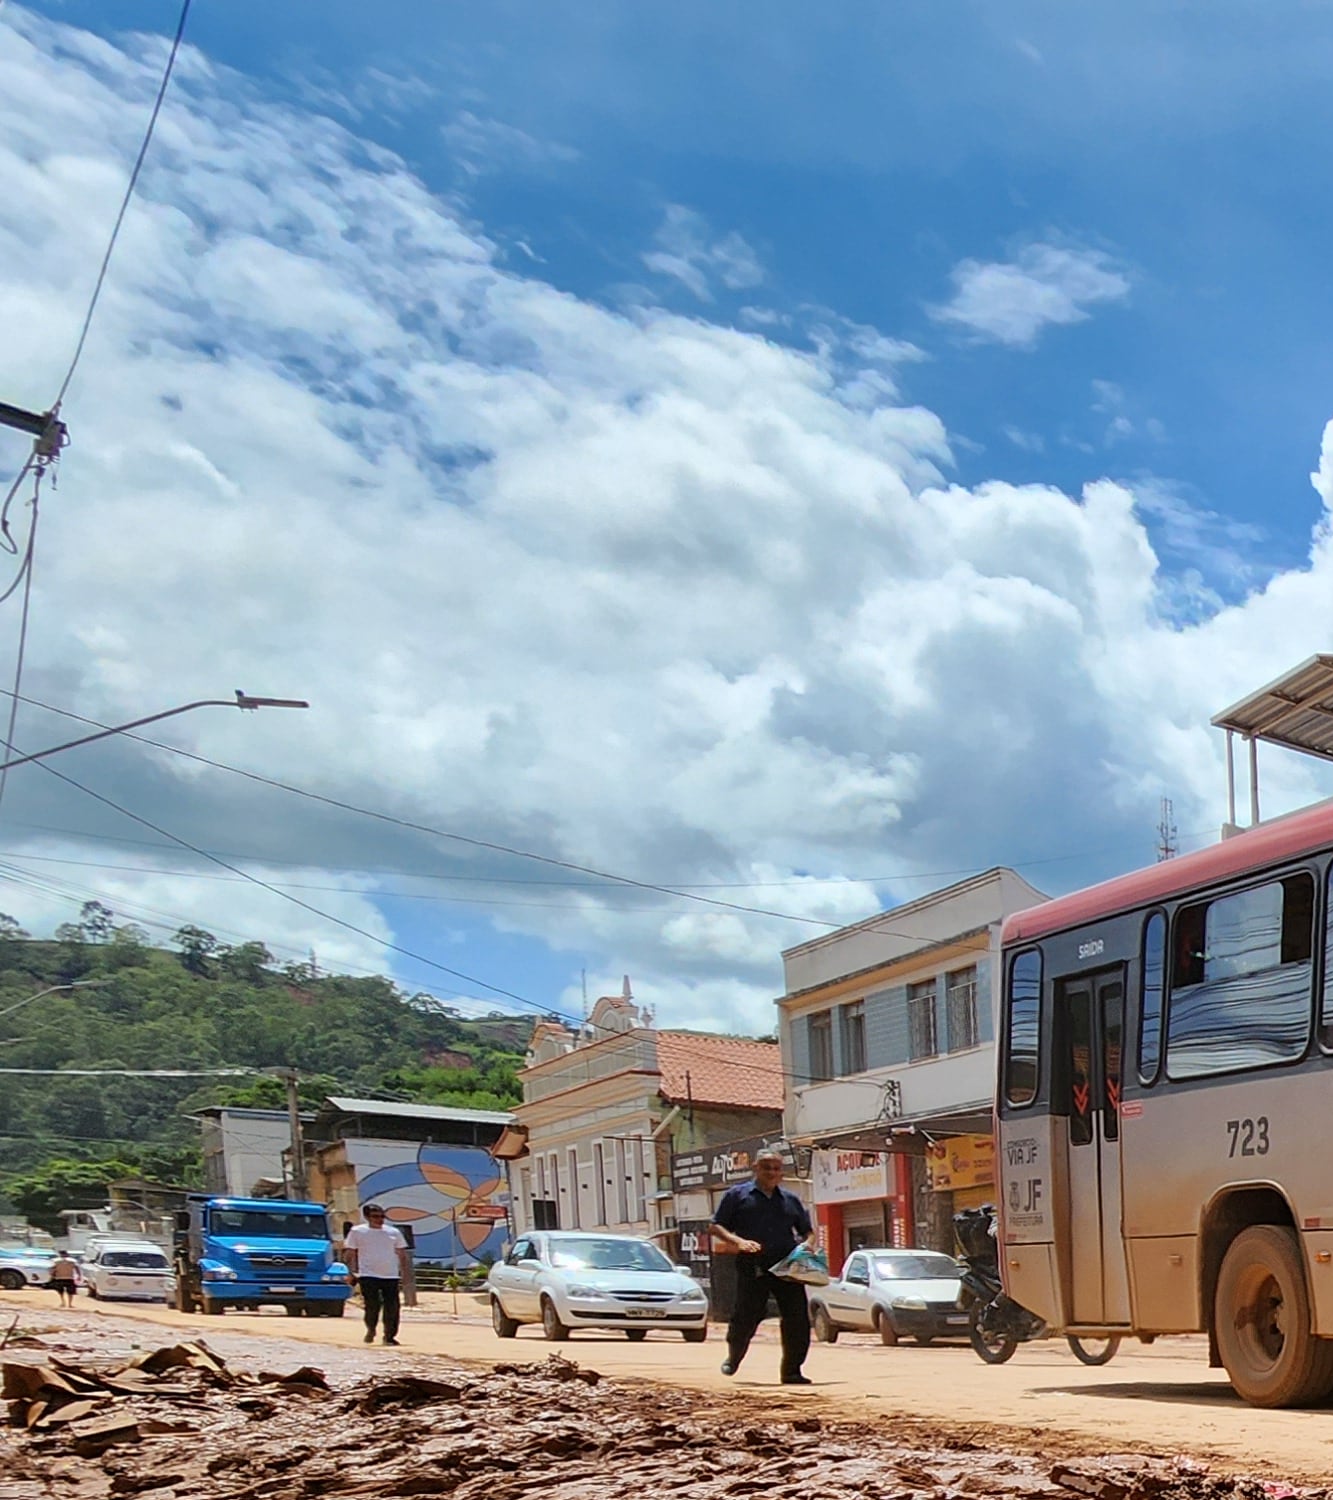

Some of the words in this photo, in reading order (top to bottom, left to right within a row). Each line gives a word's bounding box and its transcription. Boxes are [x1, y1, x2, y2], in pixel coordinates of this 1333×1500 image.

[1227, 1116, 1269, 1158] 723
[1008, 1148, 1024, 1166] VIA
[1026, 1146, 1037, 1164] JF
[1024, 1179, 1042, 1212] JF
